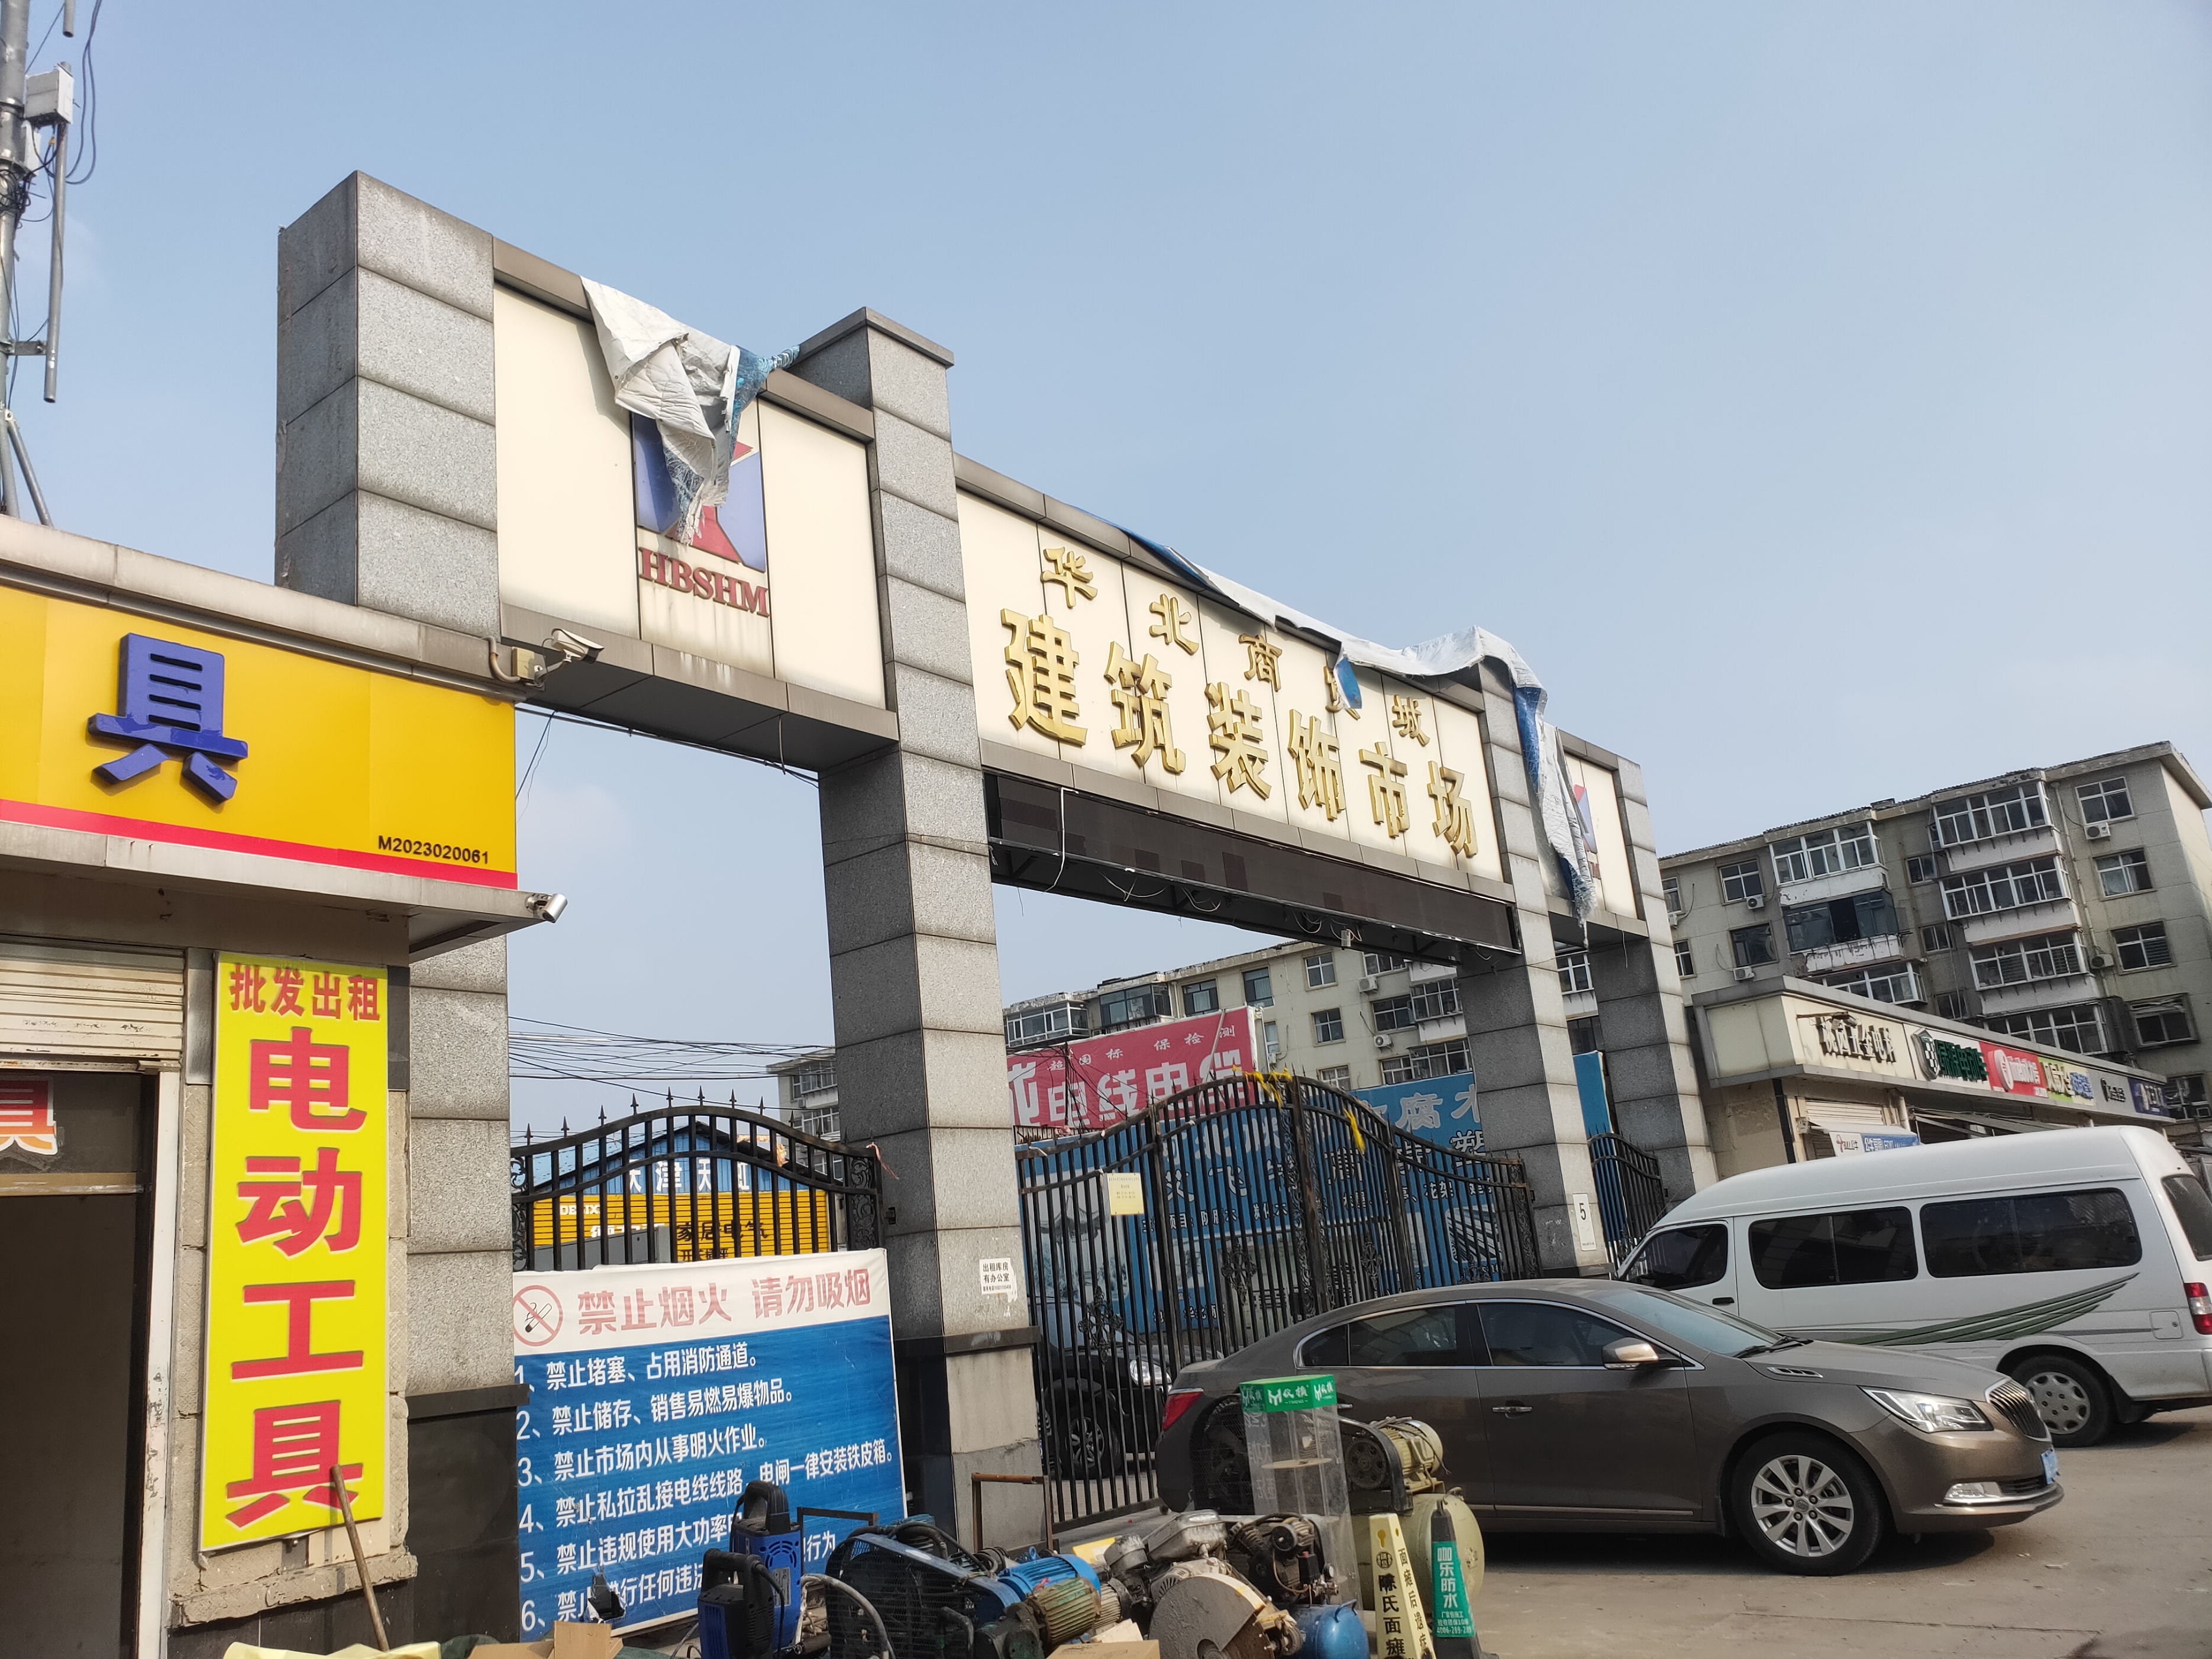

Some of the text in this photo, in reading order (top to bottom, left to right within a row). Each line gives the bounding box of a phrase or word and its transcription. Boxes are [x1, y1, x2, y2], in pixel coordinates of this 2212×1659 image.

[638, 547, 770, 617] HBSHM
[87, 632, 248, 803] 具
[1000, 608, 1478, 858] 建筑装饰市场
[377, 835, 489, 865] M2023020061
[230, 963, 380, 1021] 批发出租
[1578, 1202, 1587, 1220] 5
[225, 1027, 367, 1529] 电动工具
[983, 1262, 1009, 1272] 出租库房
[983, 1273, 1010, 1283] 有办公室
[578, 1269, 871, 1335] 禁止烟火 请勿吸烟
[519, 1438, 892, 1533] 4、禁止私拉乱接电线线路电闸一律安装铁皮箱。
[1437, 1547, 1458, 1609] 咖乐防水
